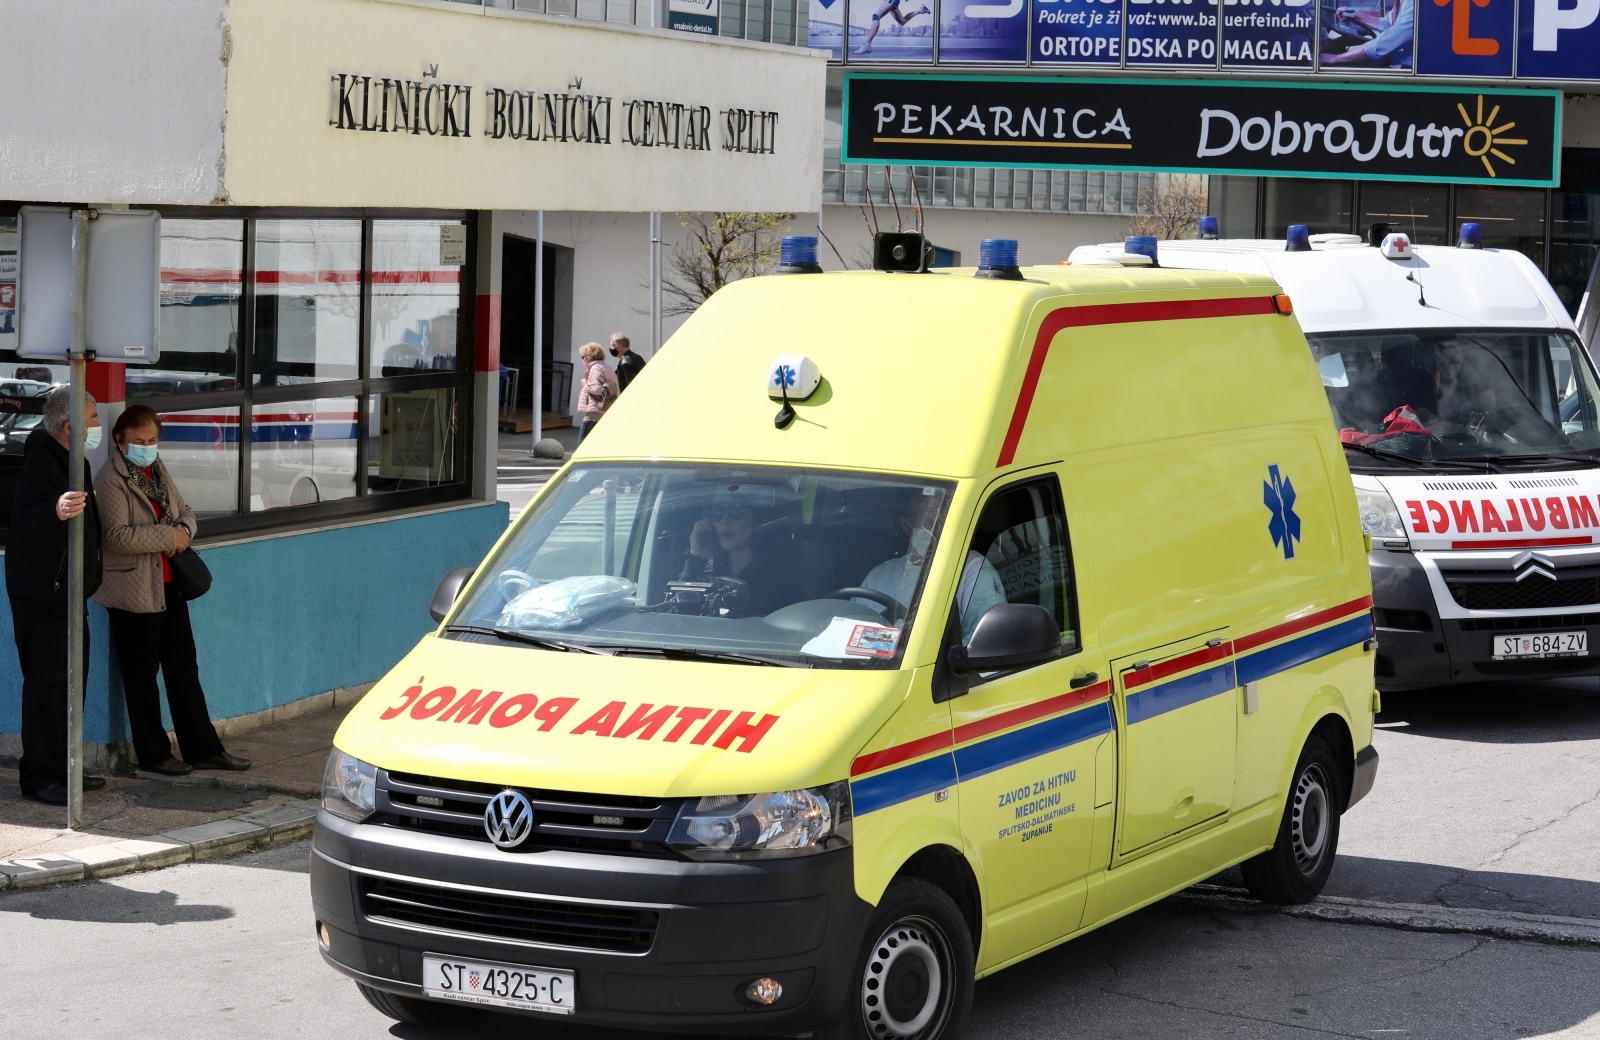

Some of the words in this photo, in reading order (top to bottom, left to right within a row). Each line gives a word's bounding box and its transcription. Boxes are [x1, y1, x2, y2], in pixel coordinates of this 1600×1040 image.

[1038, 9, 1086, 25] Pokret
[1086, 11, 1104, 28] je
[333, 63, 473, 138] KLINIČKI
[489, 76, 613, 145] BOLNIČKI
[626, 99, 713, 152] CENTAR
[722, 107, 778, 155] SPLIT
[873, 102, 1132, 140] PEKARNICA
[1504, 637, 1521, 654] ST
[1532, 633, 1585, 653] 684-ZV
[998, 785, 1031, 808] ZAVOD
[1033, 780, 1046, 796] ZA
[1048, 769, 1077, 791] HITNU
[1015, 791, 1061, 820] MEDICINU
[998, 803, 1076, 839] SPLITSKO-DALMATINSKE
[1021, 822, 1053, 843] ŽUPANIJE
[440, 962, 466, 991] ST
[482, 968, 563, 1004] 4325-C
